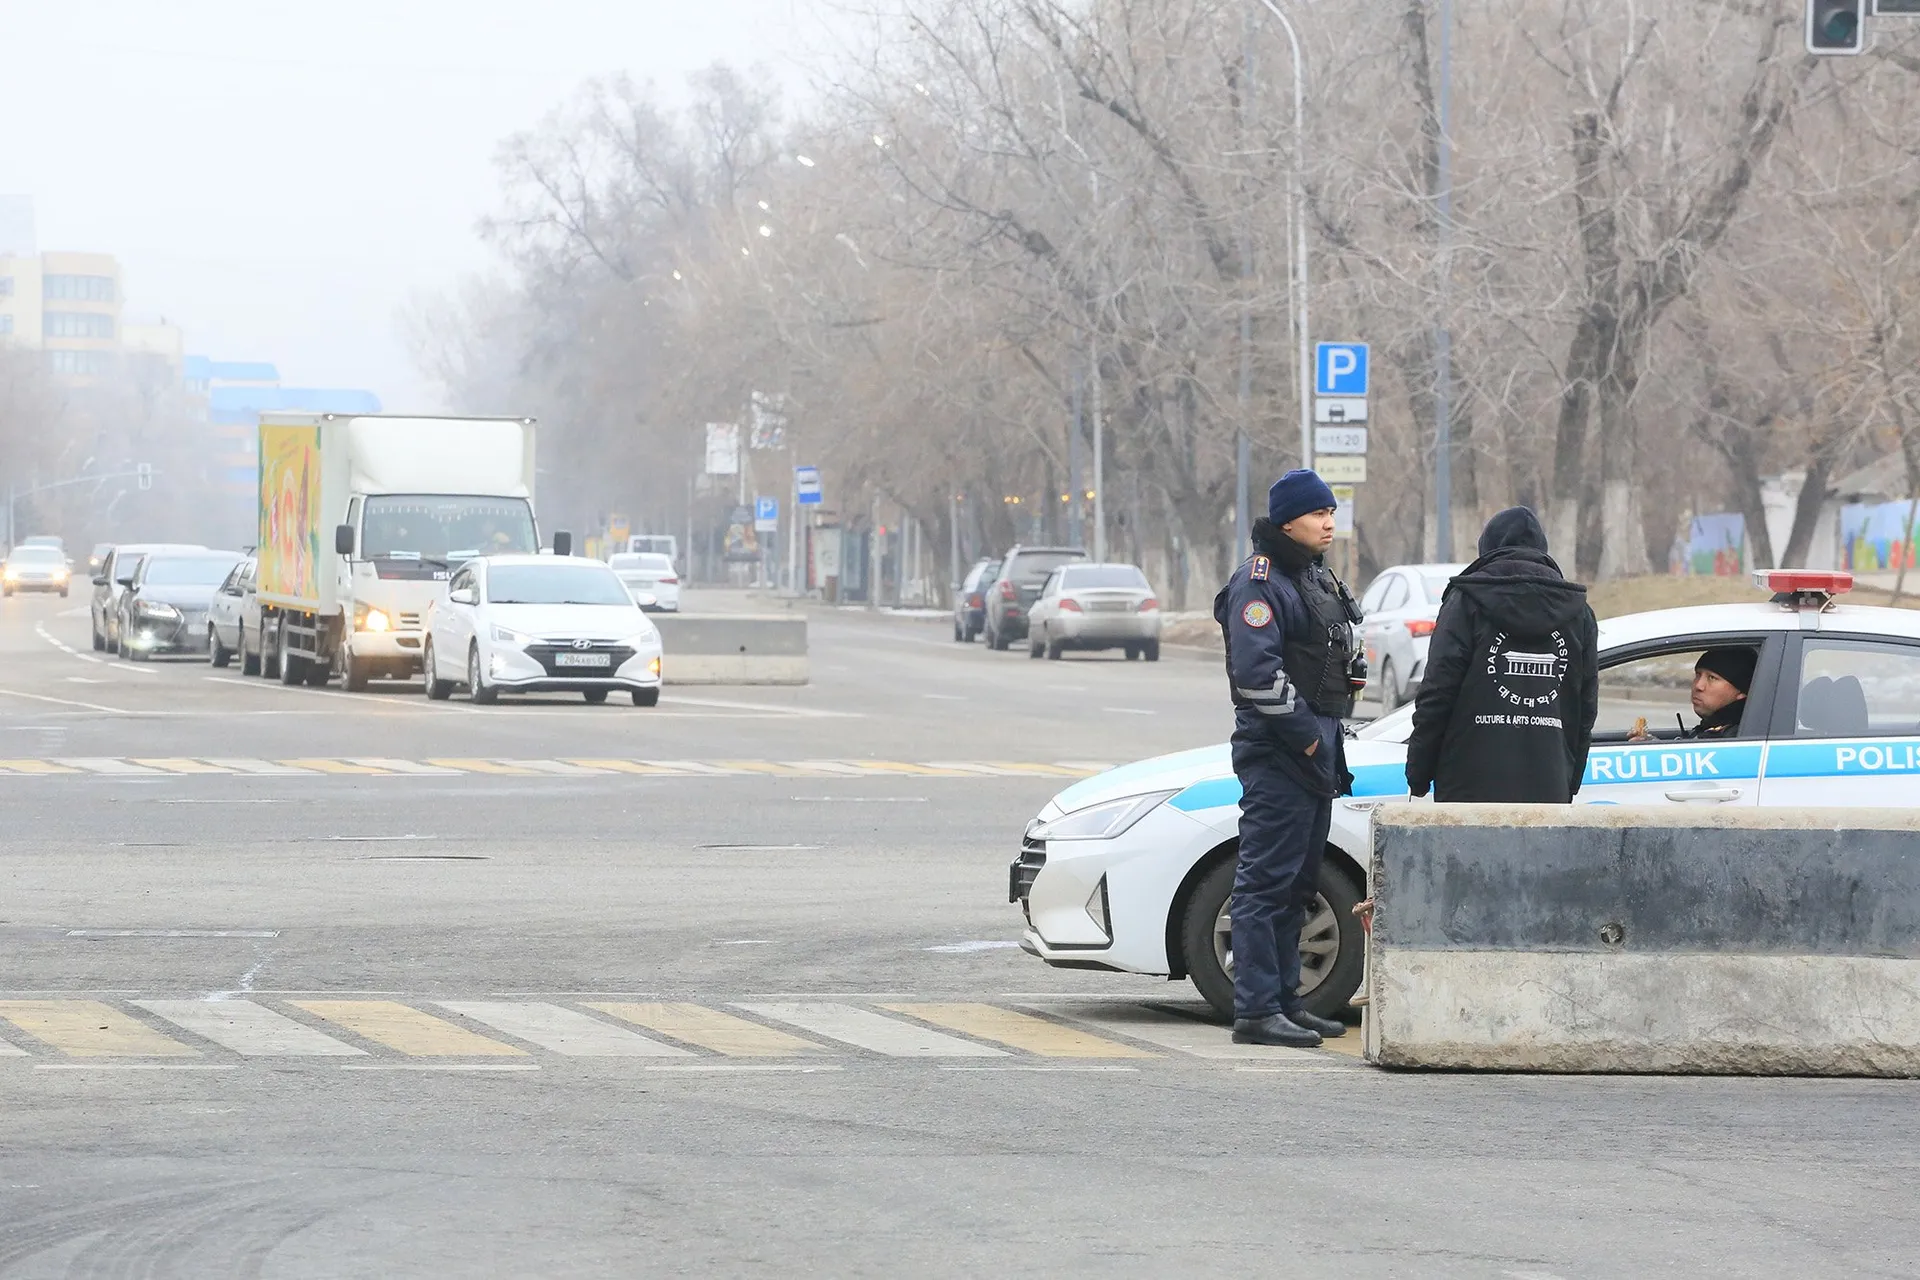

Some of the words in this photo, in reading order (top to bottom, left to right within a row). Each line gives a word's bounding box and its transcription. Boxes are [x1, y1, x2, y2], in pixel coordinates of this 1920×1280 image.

[1327, 348, 1357, 390] P
[433, 571, 455, 580] ISU
[1487, 632, 1508, 675] DAEJI
[1551, 630, 1568, 682] ERSITY
[1498, 685, 1559, 708] 대진대학교
[1475, 714, 1505, 724] CULTURE
[1506, 714, 1511, 724] &
[1512, 715, 1530, 725] ARTS
[1590, 751, 1720, 780] RÚLDIK
[1836, 745, 1920, 770] POLI
